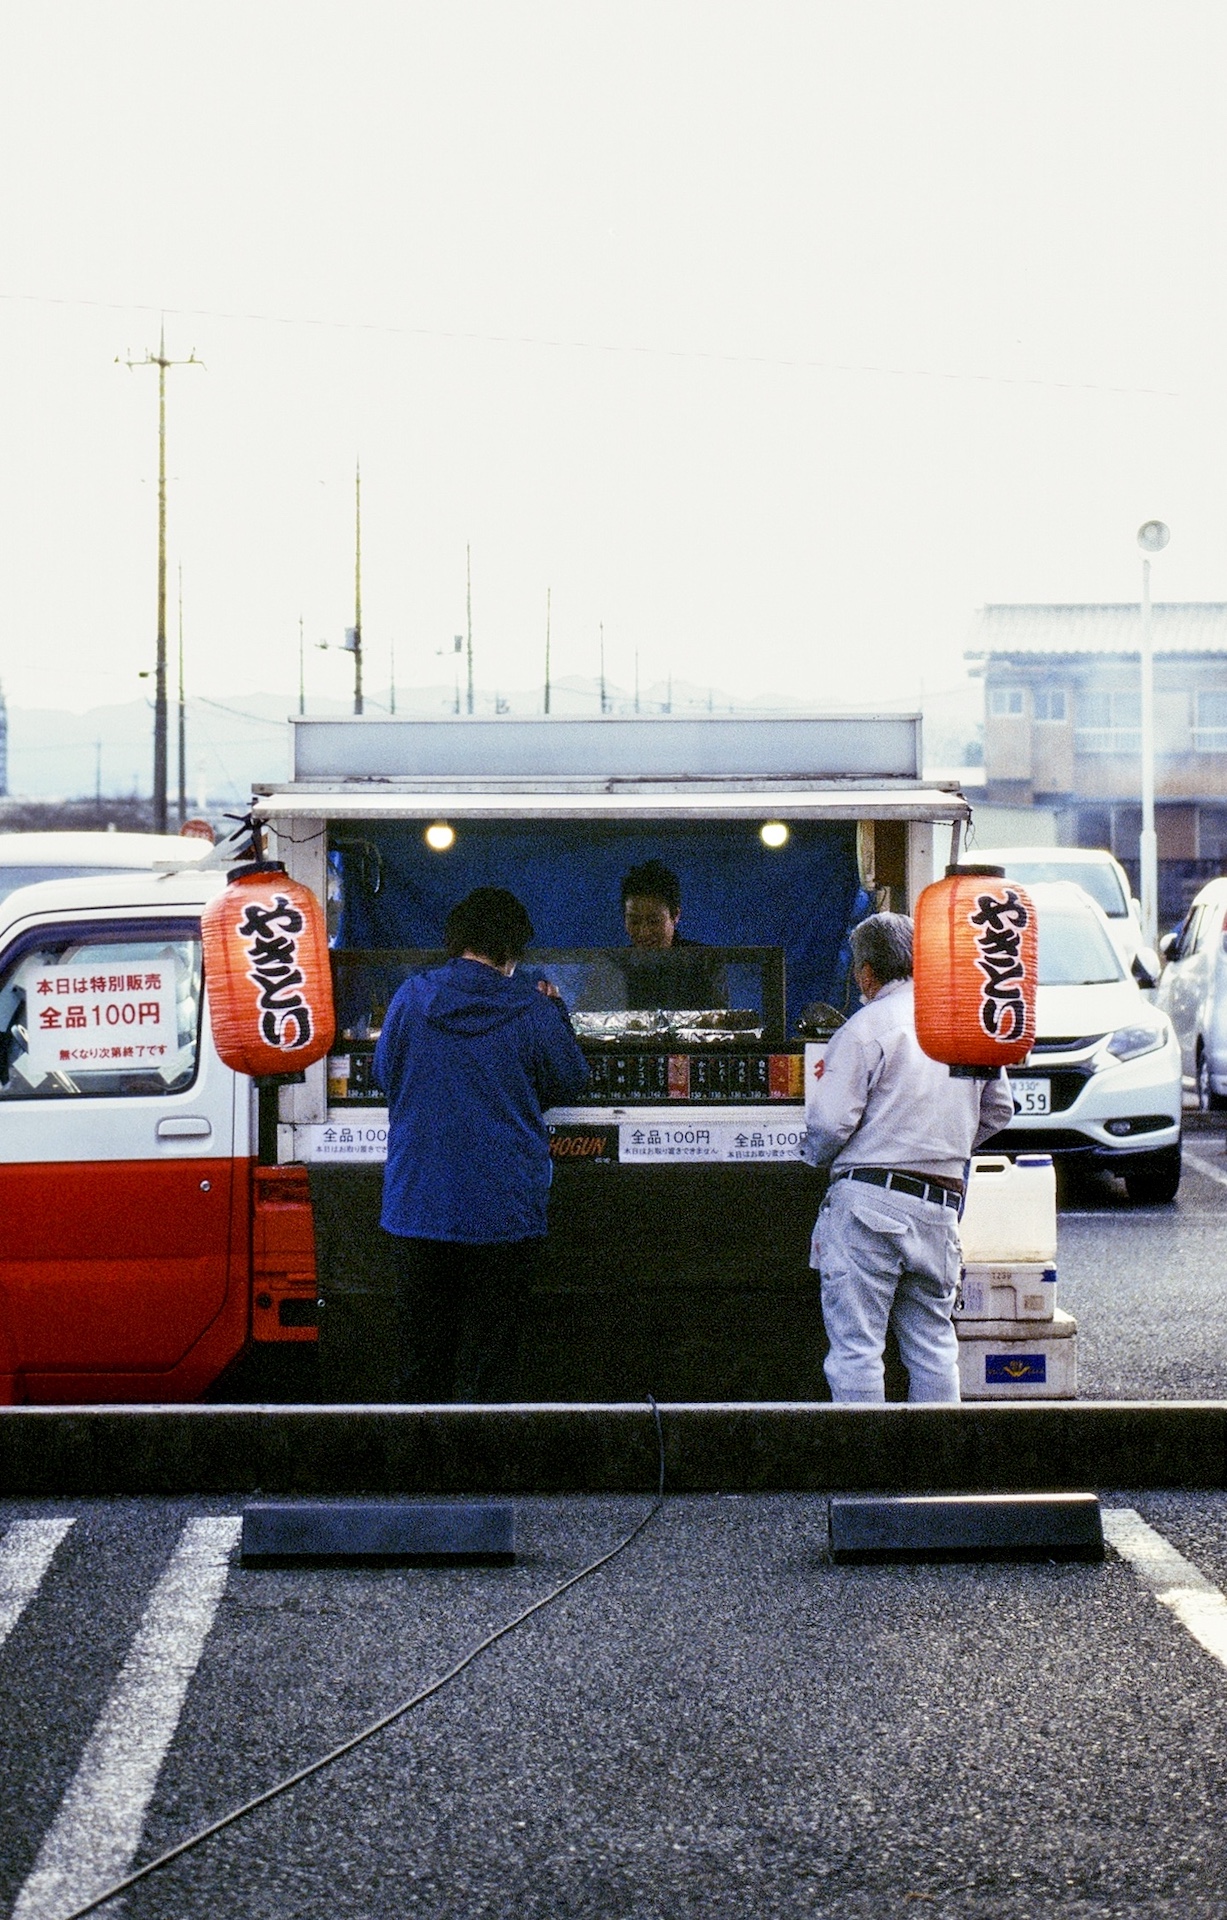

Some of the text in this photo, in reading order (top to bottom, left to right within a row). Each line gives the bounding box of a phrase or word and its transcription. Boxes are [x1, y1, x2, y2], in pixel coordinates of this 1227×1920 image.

[238, 896, 312, 1049] やきとり
[970, 890, 1028, 1042] やきとり
[36, 973, 162, 996] 本日は特別販売
[39, 1002, 161, 1030] 全品100円
[59, 1044, 168, 1061] 無くなり次第終了です
[1026, 1093, 1047, 1111] 59
[549, 1136, 607, 1156] HOGUN
[631, 1129, 710, 1145] 全品100円
